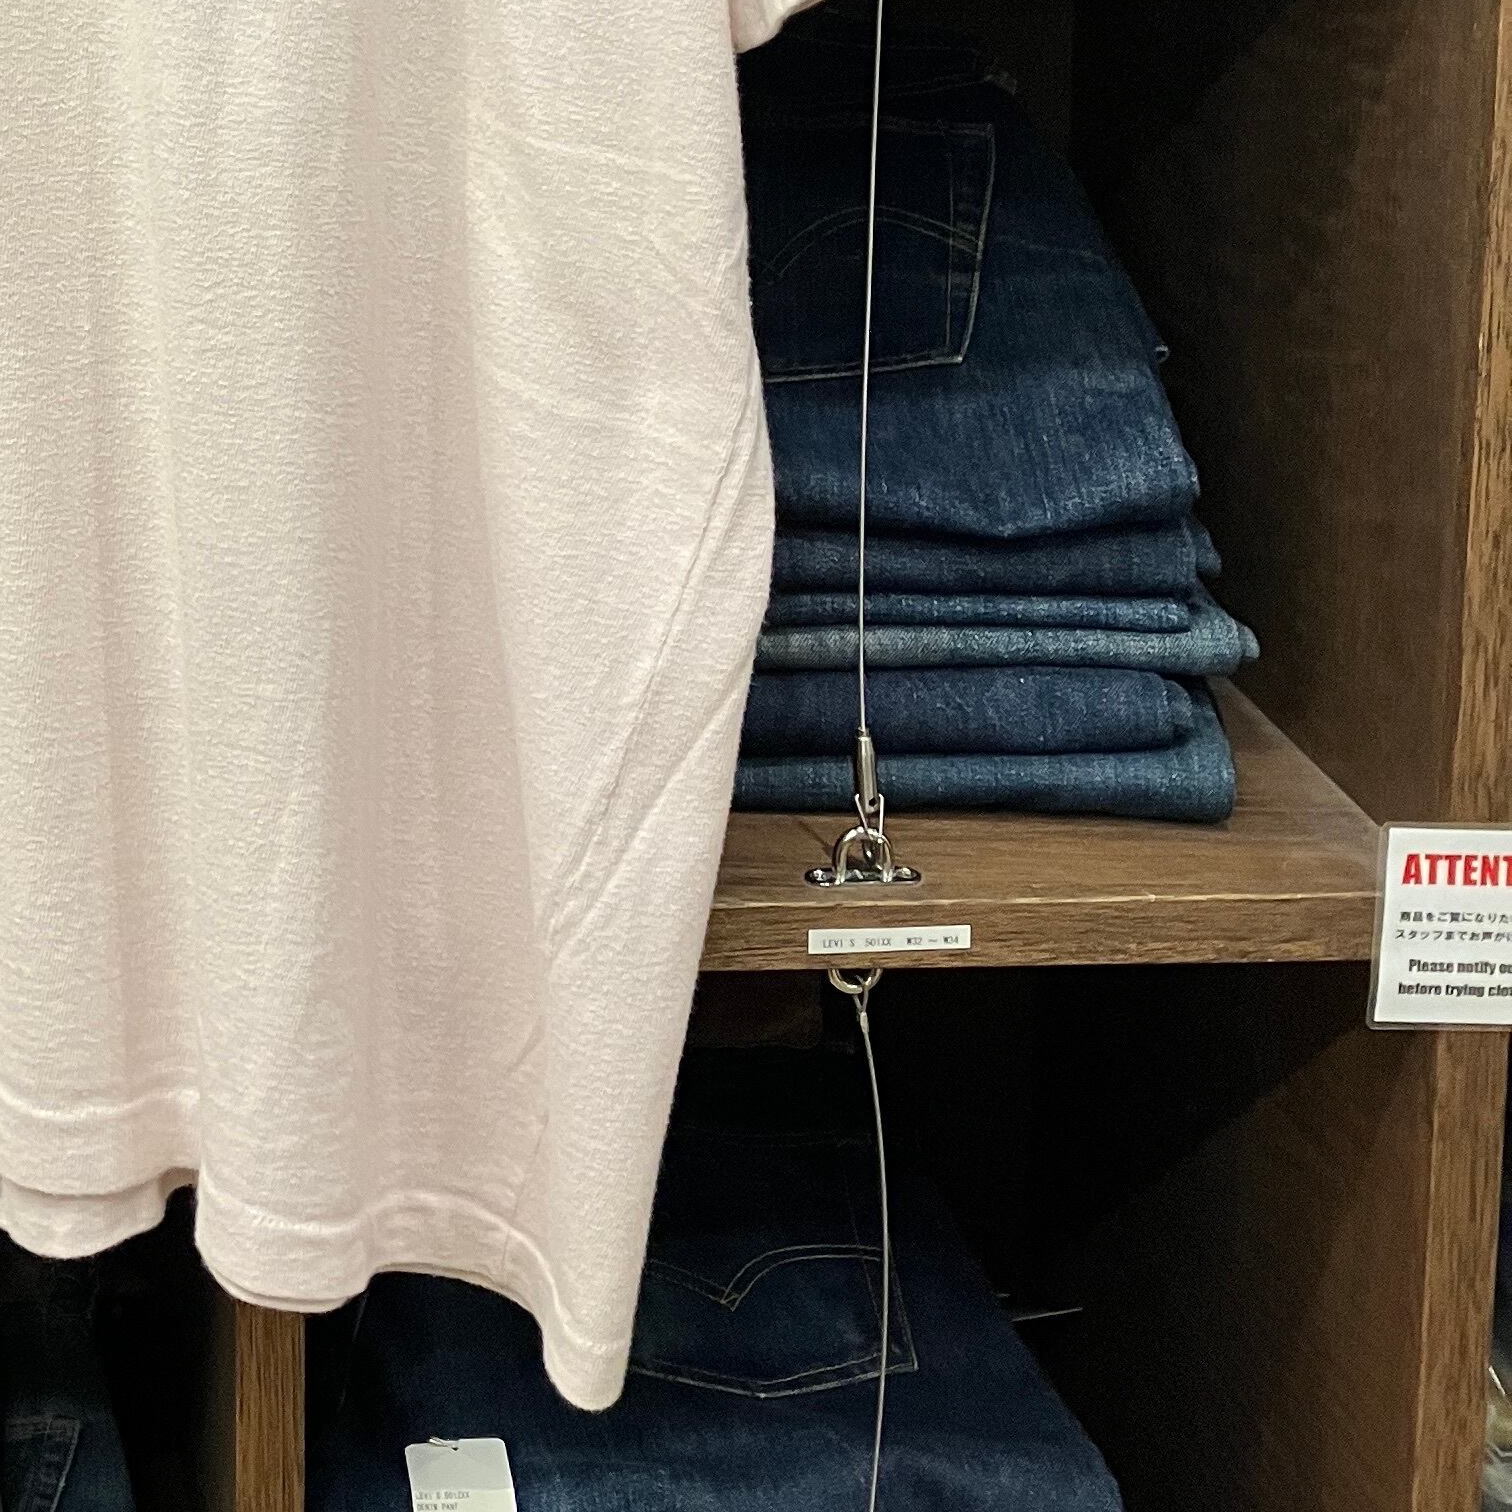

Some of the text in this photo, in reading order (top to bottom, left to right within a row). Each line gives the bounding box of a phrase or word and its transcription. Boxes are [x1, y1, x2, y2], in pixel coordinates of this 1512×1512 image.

[1408, 958, 1454, 974] Please
[1457, 960, 1496, 976] notify
[1398, 982, 1441, 996] before
[1445, 983, 1485, 998] trying
